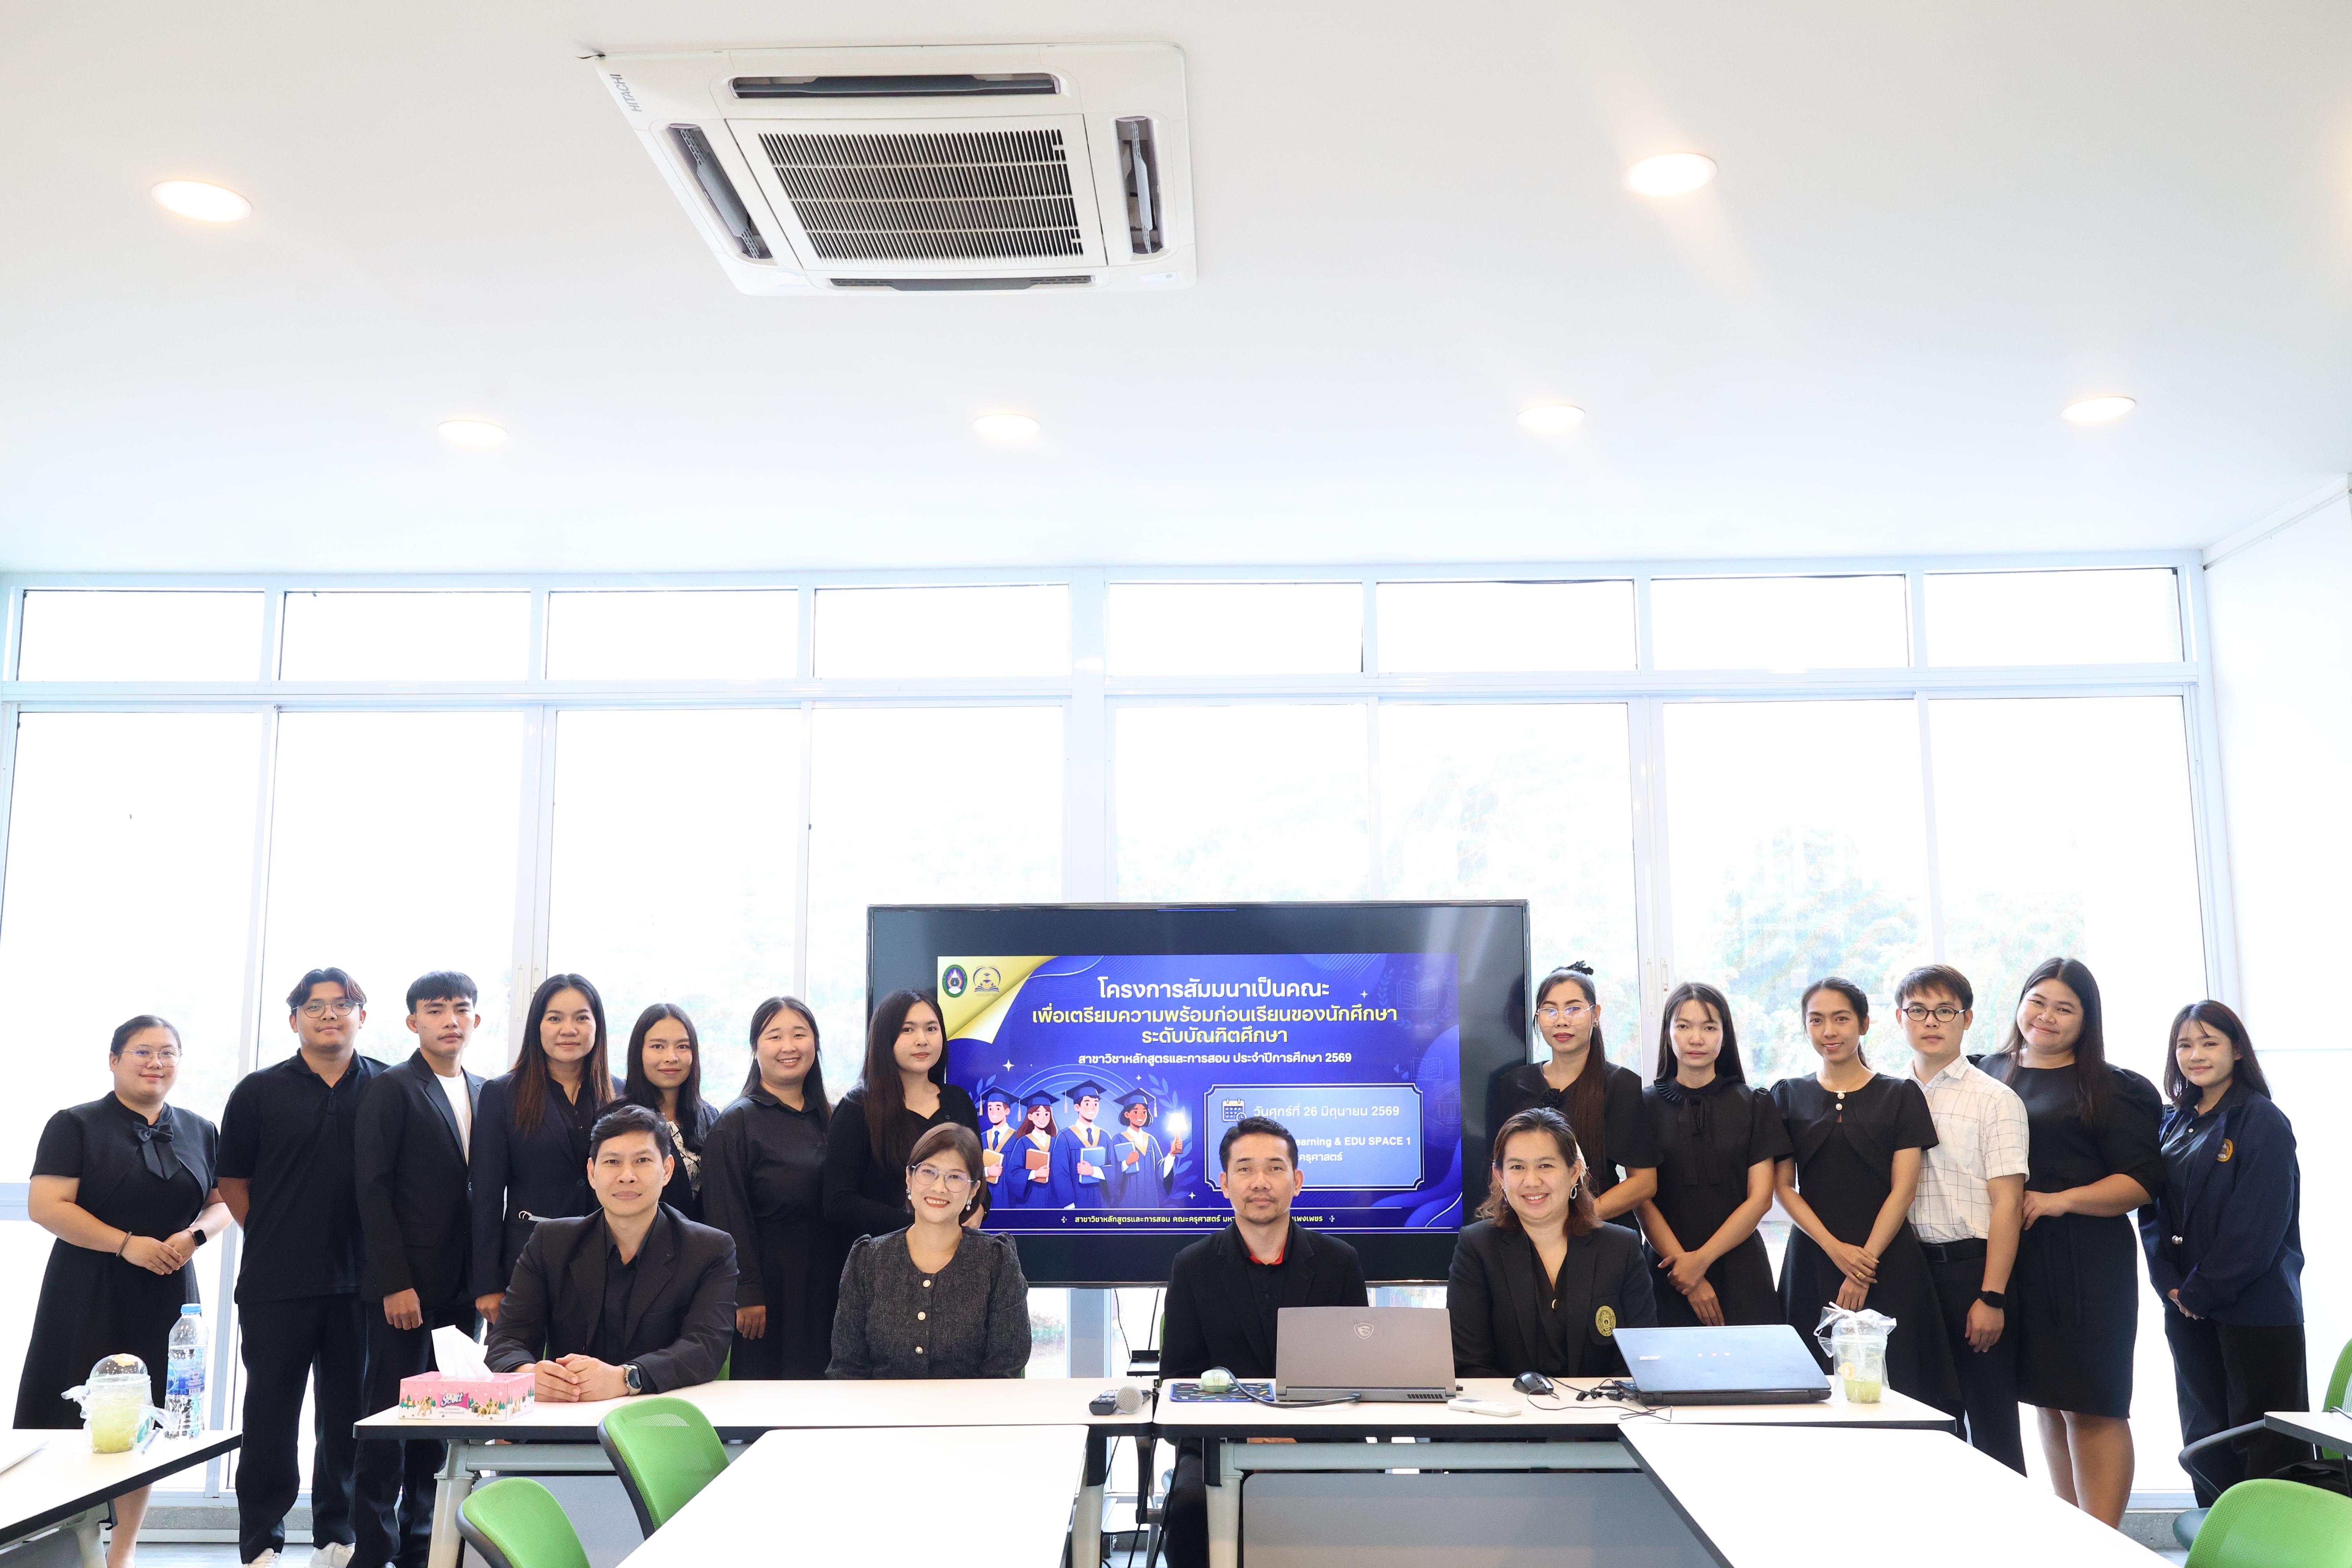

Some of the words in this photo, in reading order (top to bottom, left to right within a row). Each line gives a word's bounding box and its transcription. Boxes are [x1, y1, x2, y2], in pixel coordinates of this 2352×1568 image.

[609, 74, 642, 112] HITACHI
[1097, 976, 1329, 998] โครงการสัมมนาเป็นคณะ
[1033, 1003, 1397, 1023] เพื่อเตรียมความพร้อมก่อนเรียนของนักศึกษา
[1142, 1025, 1287, 1043] ระดับบัณฑิตศึกษา
[1078, 1053, 1230, 1067] สาขาวิชาหลักสูตรและการสอน
[1233, 1051, 1322, 1063] ประจำปีการศึกษา
[1325, 1053, 1352, 1062] 2569
[1254, 1103, 1300, 1119] วันศุกร์ที่
[1304, 1106, 1318, 1116] 26
[1321, 1106, 1368, 1119] มิถุนายน
[1372, 1106, 1399, 1116] 2569
[1296, 1137, 1332, 1148] earning
[1334, 1137, 1341, 1145] &
[1345, 1137, 1365, 1145] EDU
[1368, 1137, 1403, 1145] SPACE
[1299, 1152, 1343, 1164] ครุศาสตร์
[1075, 1215, 1170, 1225] สาขาวิชาหลักสูตรและการสอน
[1173, 1215, 1221, 1225] คณะครุศาสตร์
[440, 1392, 463, 1407] Scott
